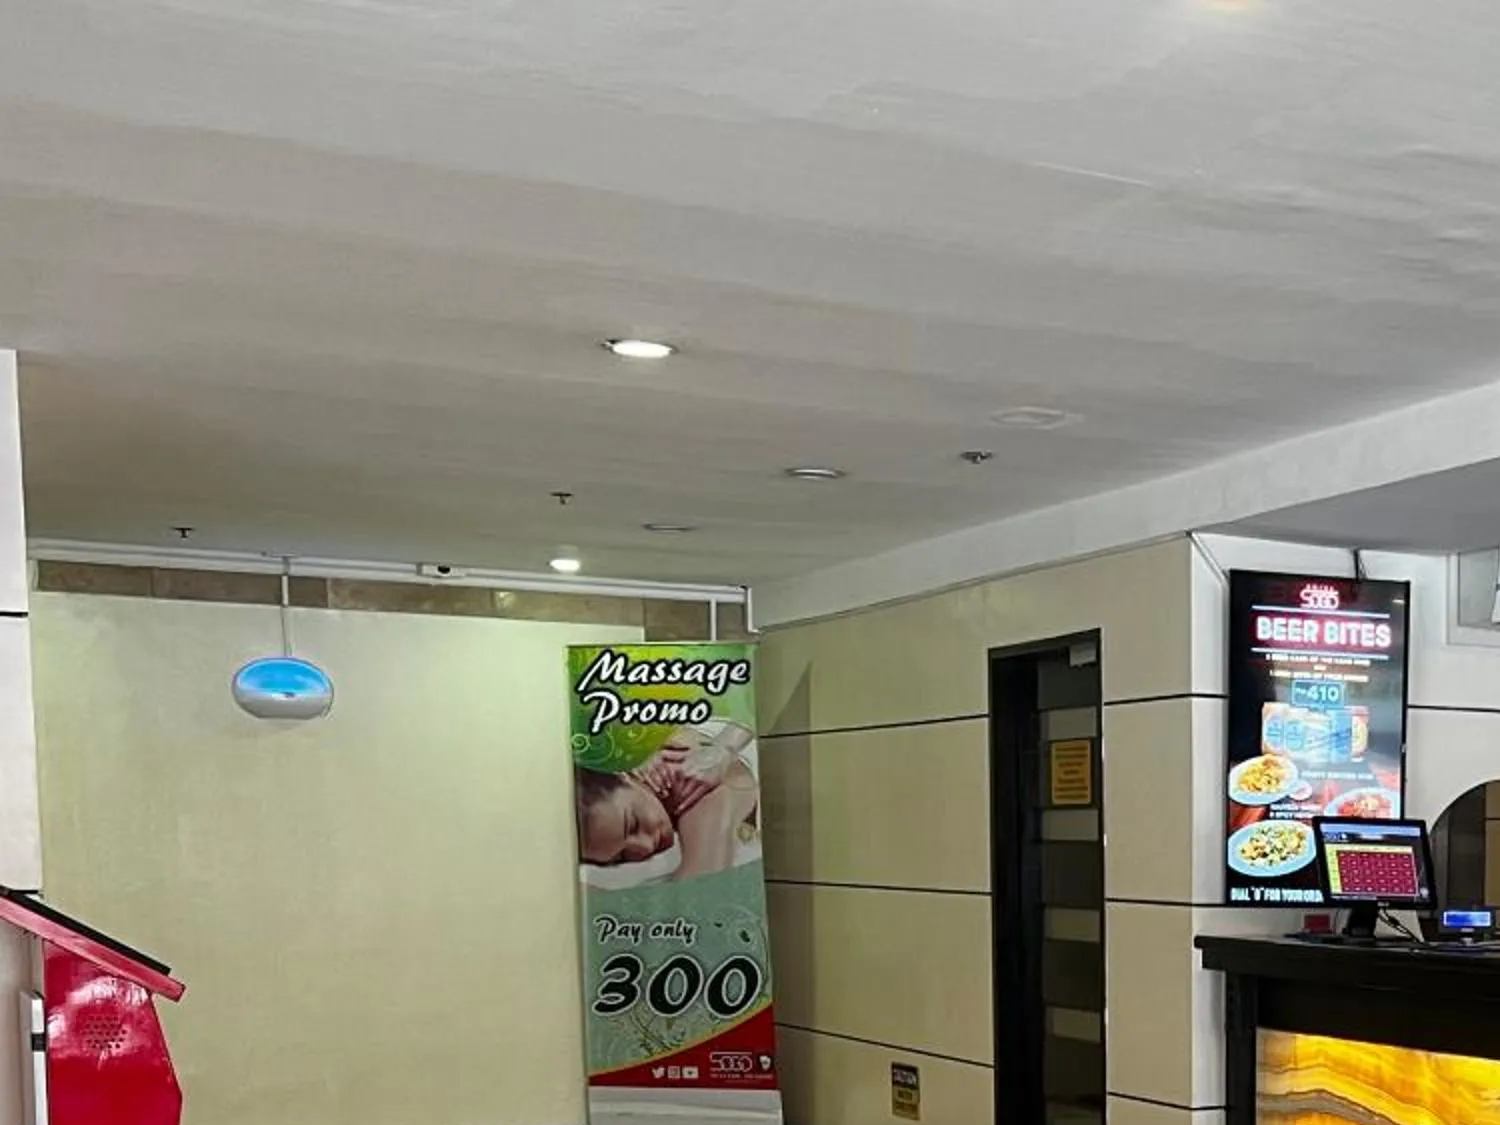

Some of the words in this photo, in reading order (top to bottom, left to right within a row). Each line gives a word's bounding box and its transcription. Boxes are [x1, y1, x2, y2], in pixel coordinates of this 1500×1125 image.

[1256, 615, 1320, 643] BEER
[1323, 620, 1392, 648] BITES
[576, 650, 749, 694] Massage
[581, 690, 711, 734] Promo
[594, 916, 642, 943] Pay
[651, 917, 696, 947] only
[592, 953, 762, 1019] 300
